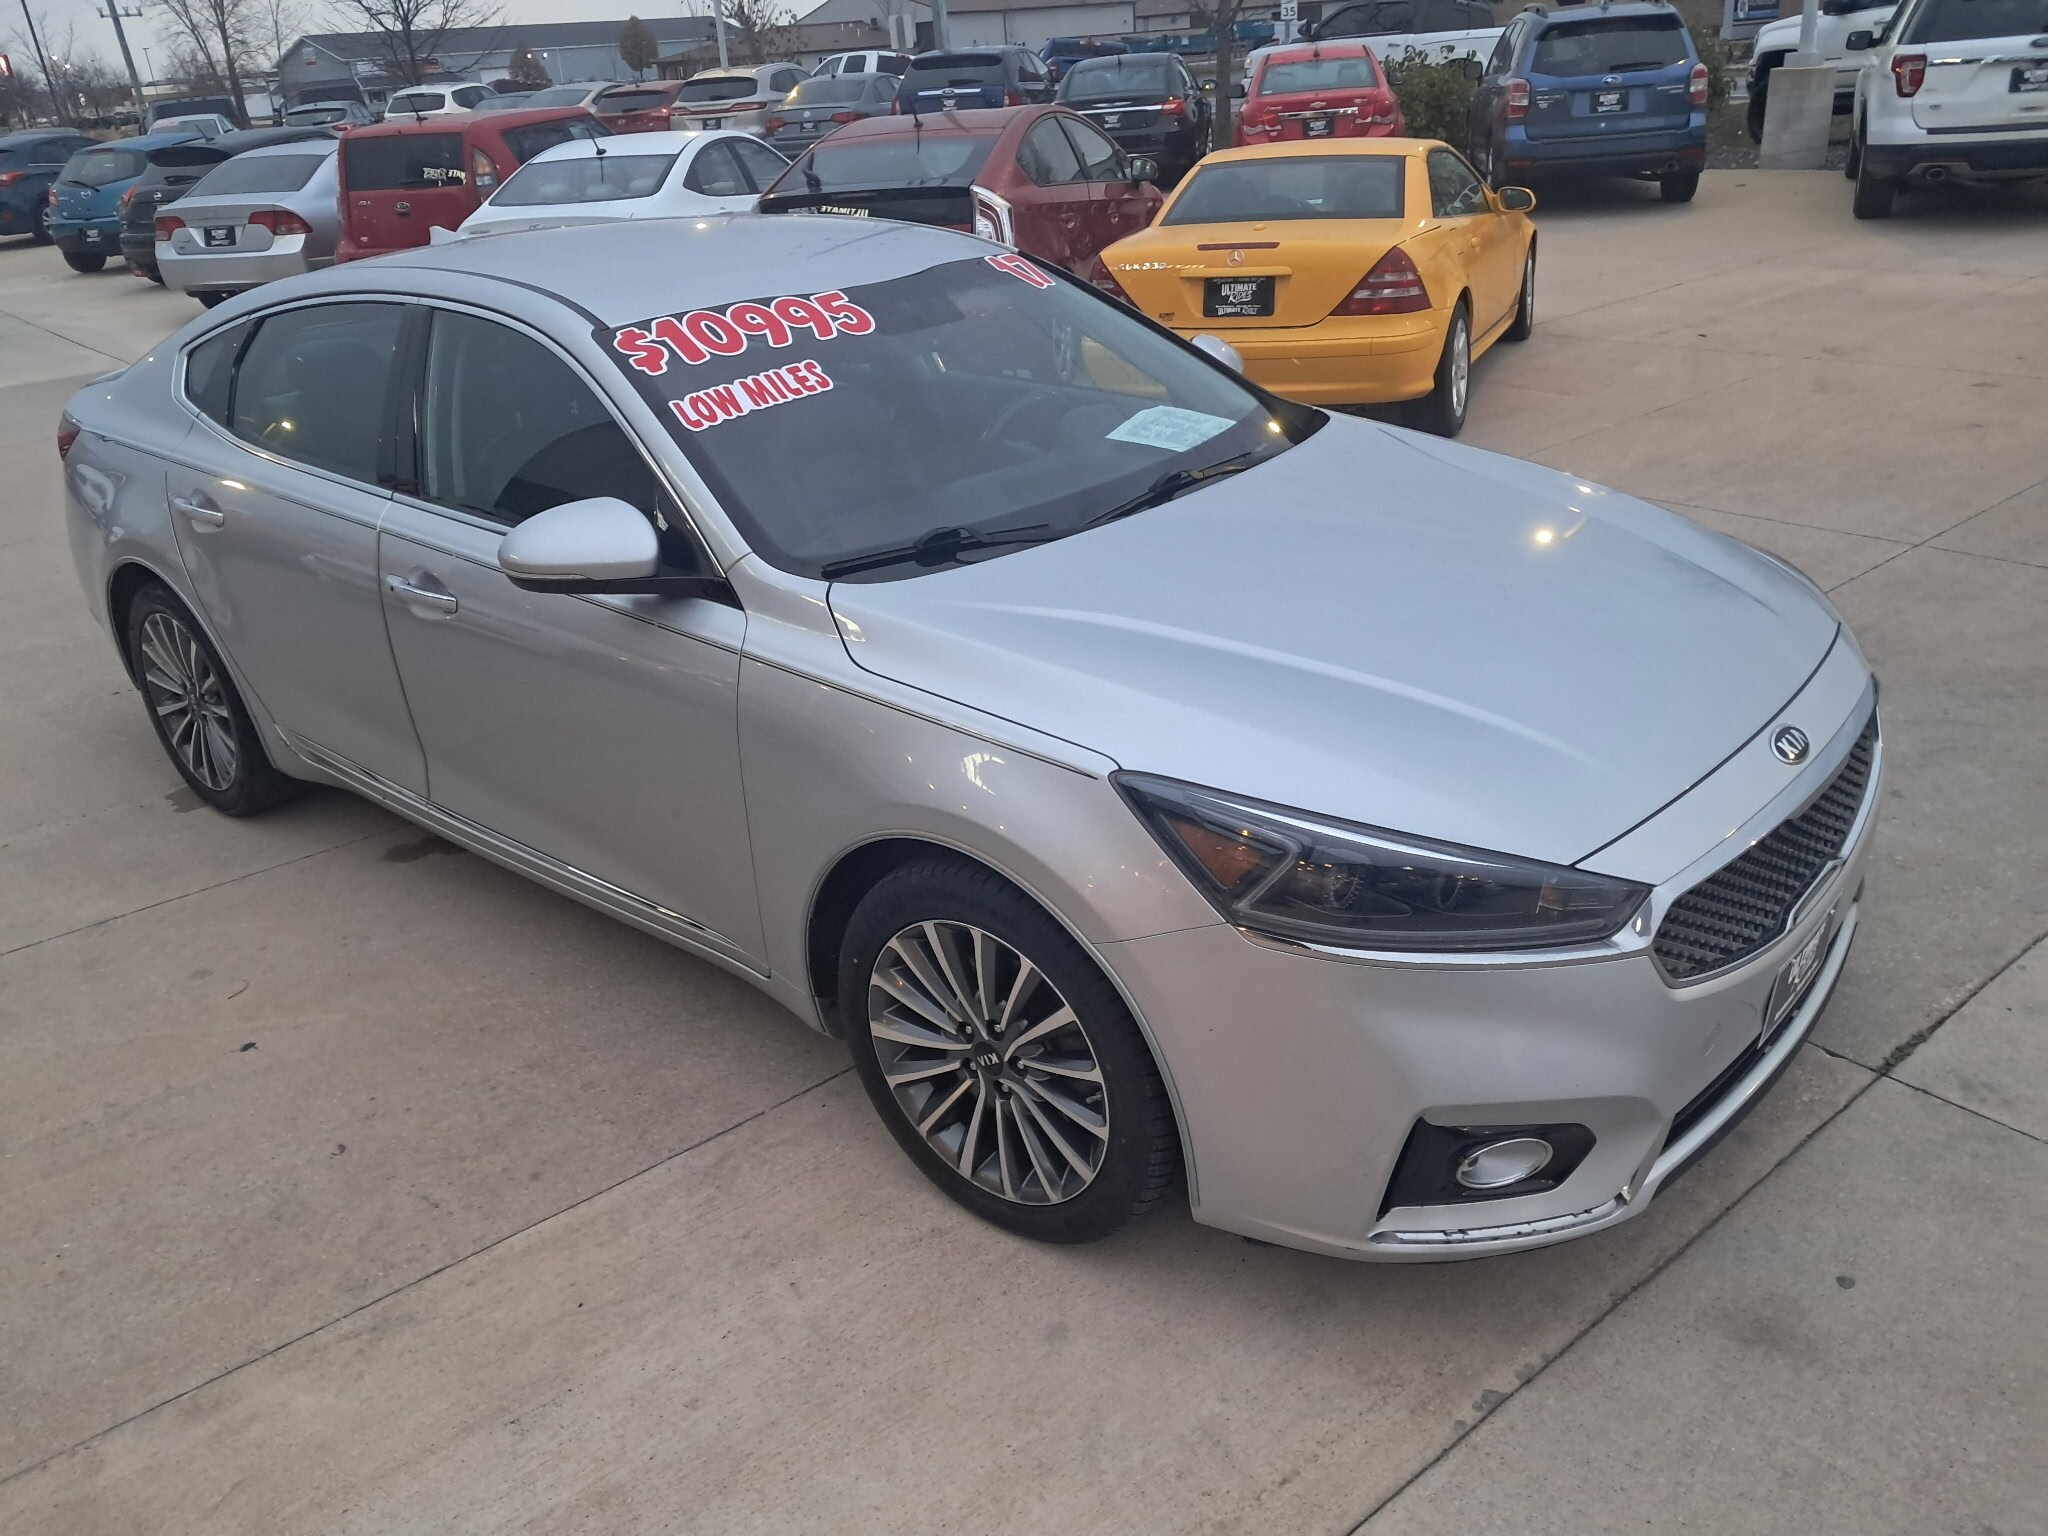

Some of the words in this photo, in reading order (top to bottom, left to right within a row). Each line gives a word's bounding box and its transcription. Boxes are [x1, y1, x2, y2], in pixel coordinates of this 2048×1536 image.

[1283, 7, 1296, 17] 35
[1221, 283, 1257, 296] ULTIMATE
[614, 291, 875, 376] $10995
[669, 383, 742, 431] LOW
[740, 360, 833, 409] MILES
[1776, 729, 1808, 759] KIA
[976, 1053, 999, 1067] KIA
